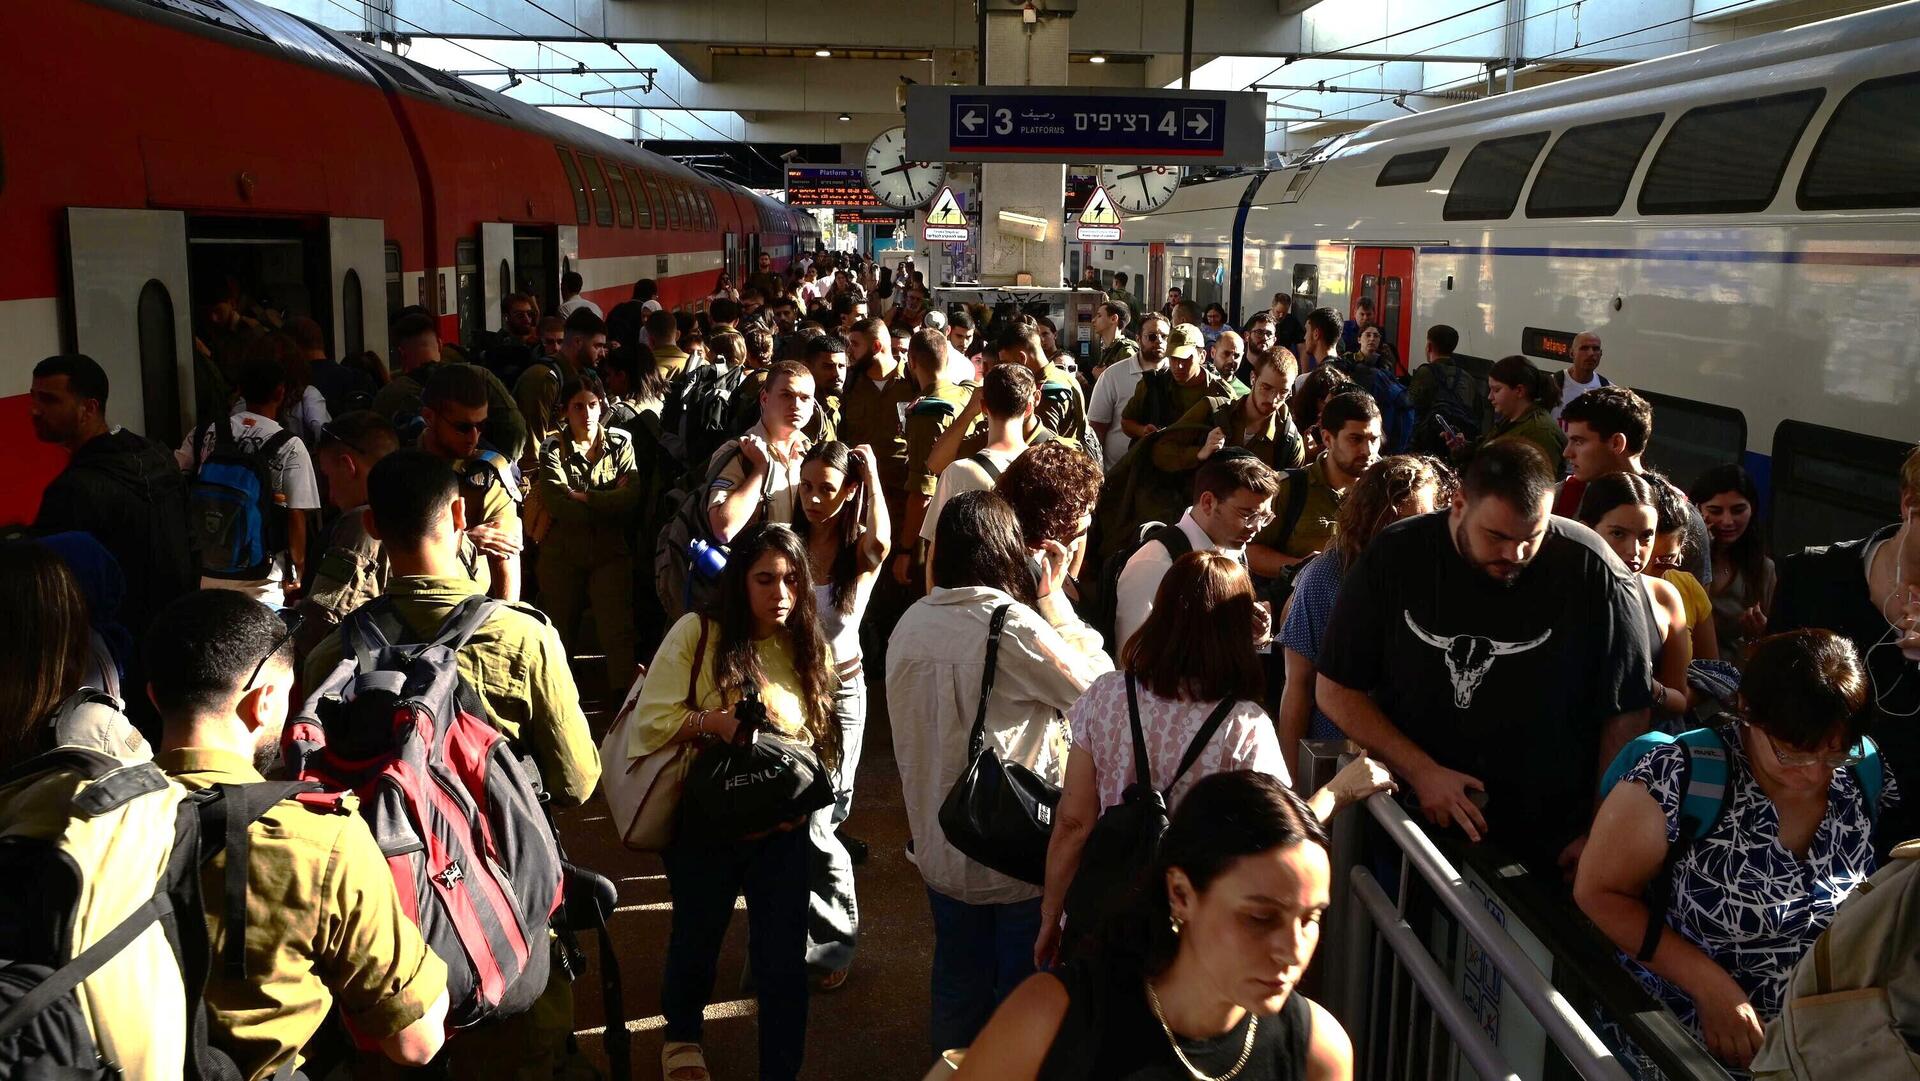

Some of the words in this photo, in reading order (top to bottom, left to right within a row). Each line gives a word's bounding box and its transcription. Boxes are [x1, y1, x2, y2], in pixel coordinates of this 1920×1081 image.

[994, 108, 1013, 135] 3
[1074, 112, 1150, 132] רציפים
[1157, 111, 1177, 136] 4
[1020, 126, 1065, 135] PLATFORMS
